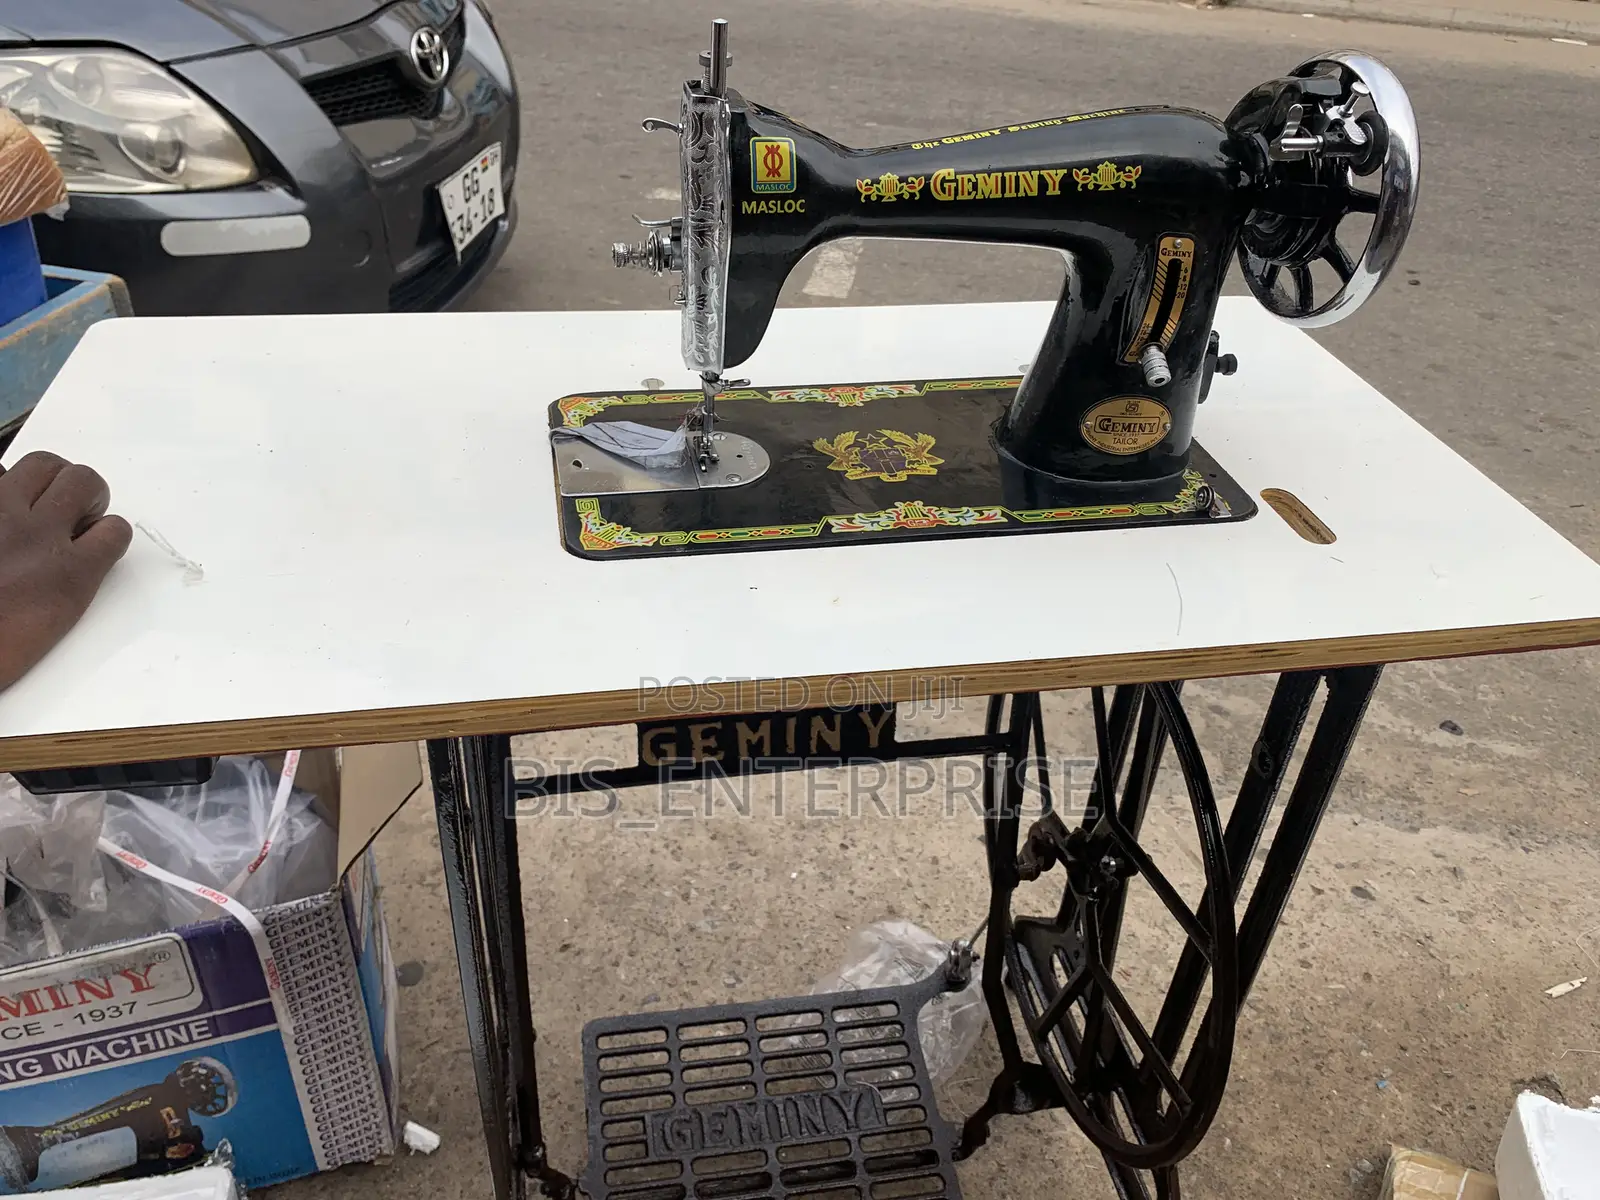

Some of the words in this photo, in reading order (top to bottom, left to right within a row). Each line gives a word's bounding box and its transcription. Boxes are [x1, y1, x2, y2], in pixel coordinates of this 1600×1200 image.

[942, 128, 1002, 145] GEMINY
[756, 183, 792, 191] MASLOC
[930, 168, 1067, 201] GEMINY
[741, 199, 806, 214] MASLOC
[1160, 248, 1192, 258] GEMINY
[1099, 417, 1157, 433] GEMINY
[1112, 438, 1139, 446] TAILOR
[642, 710, 897, 767] GEMINY
[1, 1021, 45, 1040] CE
[73, 1001, 138, 1026] 1937
[52, 1019, 213, 1071] MACHINE
[662, 1090, 865, 1153] GEMINY
